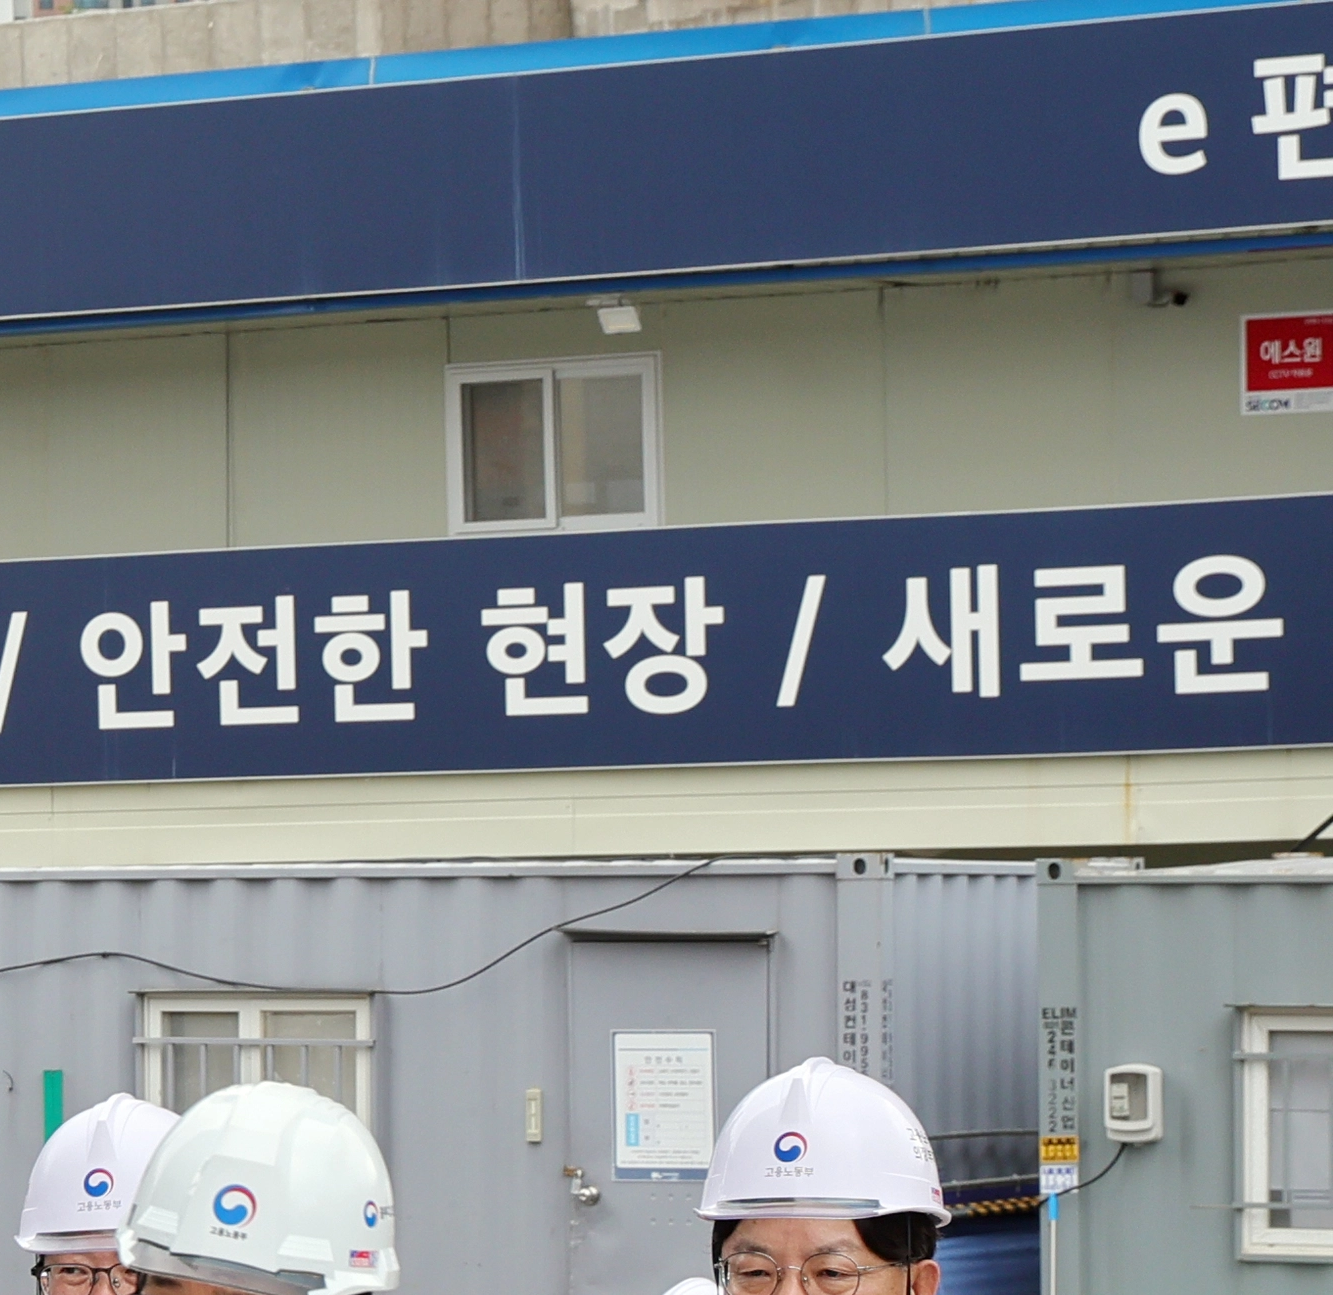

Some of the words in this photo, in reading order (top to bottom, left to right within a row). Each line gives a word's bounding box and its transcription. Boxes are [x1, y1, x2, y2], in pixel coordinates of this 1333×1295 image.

[1138, 92, 1208, 175] e
[1259, 337, 1323, 365] 에스원
[79, 590, 428, 730] 안전한
[480, 574, 725, 717] 현장
[776, 574, 826, 707] /
[881, 552, 1285, 698] 새로운
[1041, 1007, 1077, 1020] ELIM
[764, 1166, 815, 1178] 고용노동부
[77, 1199, 122, 1212] 고용노동부
[209, 1226, 248, 1241] 고용노동부
